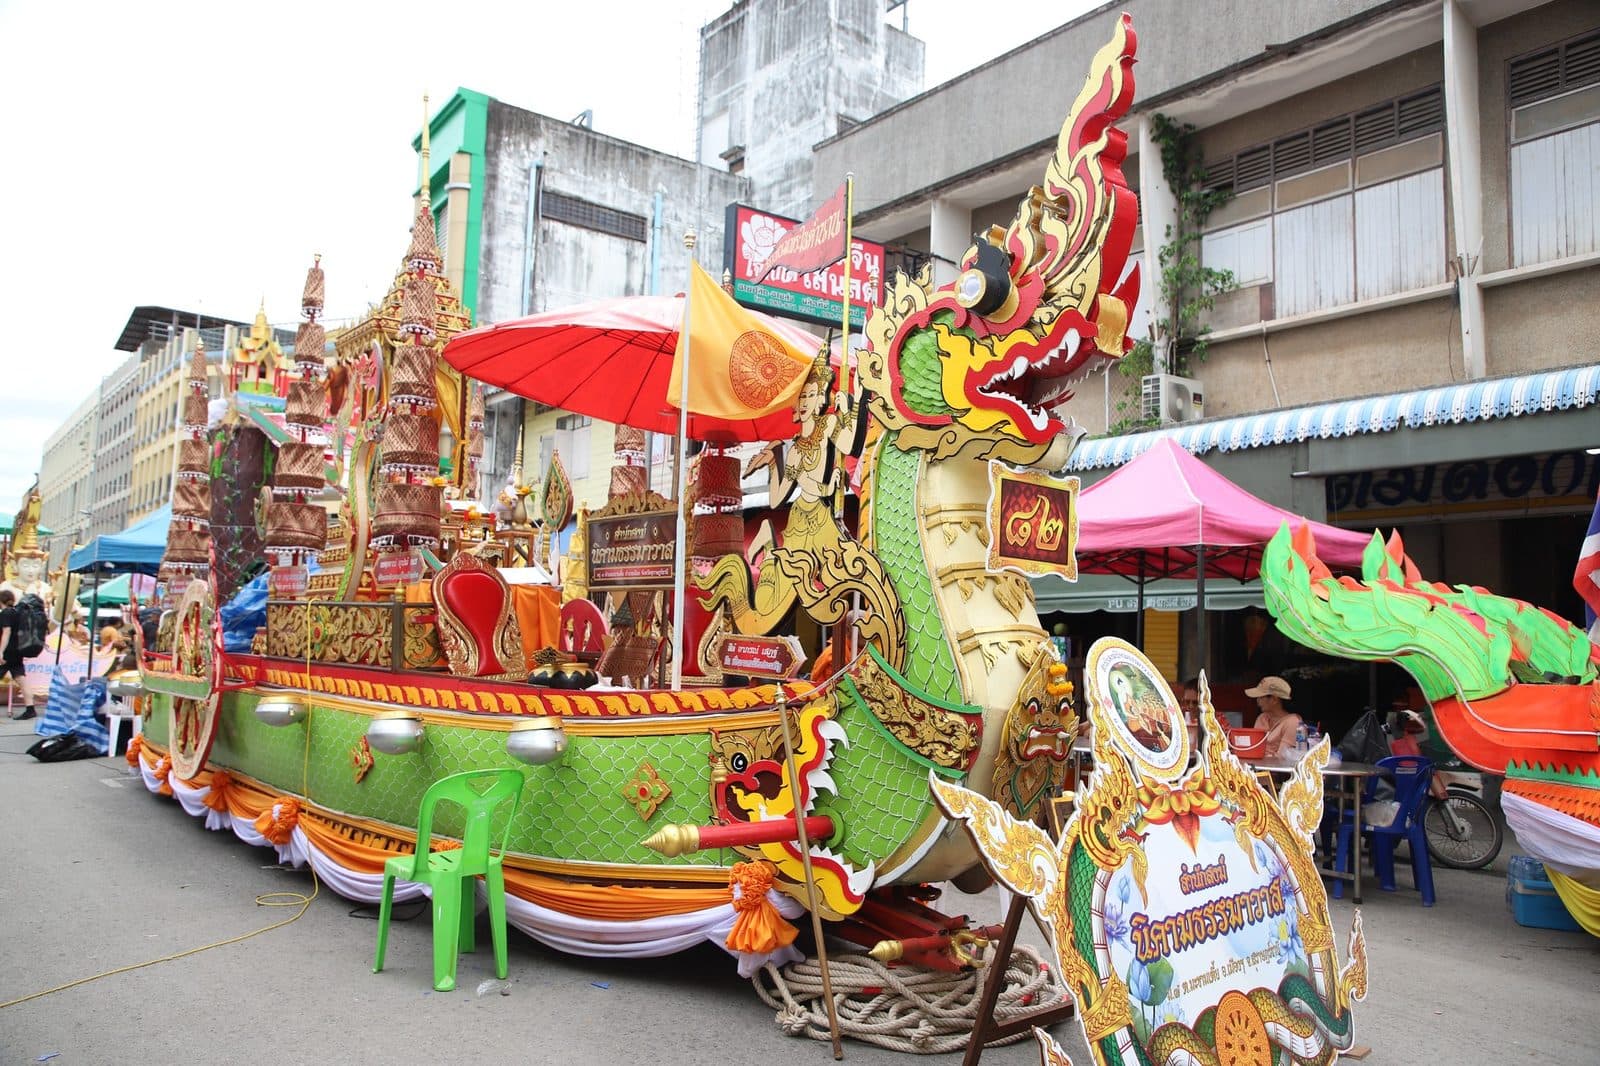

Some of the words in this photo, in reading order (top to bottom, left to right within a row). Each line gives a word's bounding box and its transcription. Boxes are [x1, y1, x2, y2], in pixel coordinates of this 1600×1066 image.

[1006, 494, 1064, 551] ๘๒
[1180, 854, 1228, 895] สำนักสงฆ์
